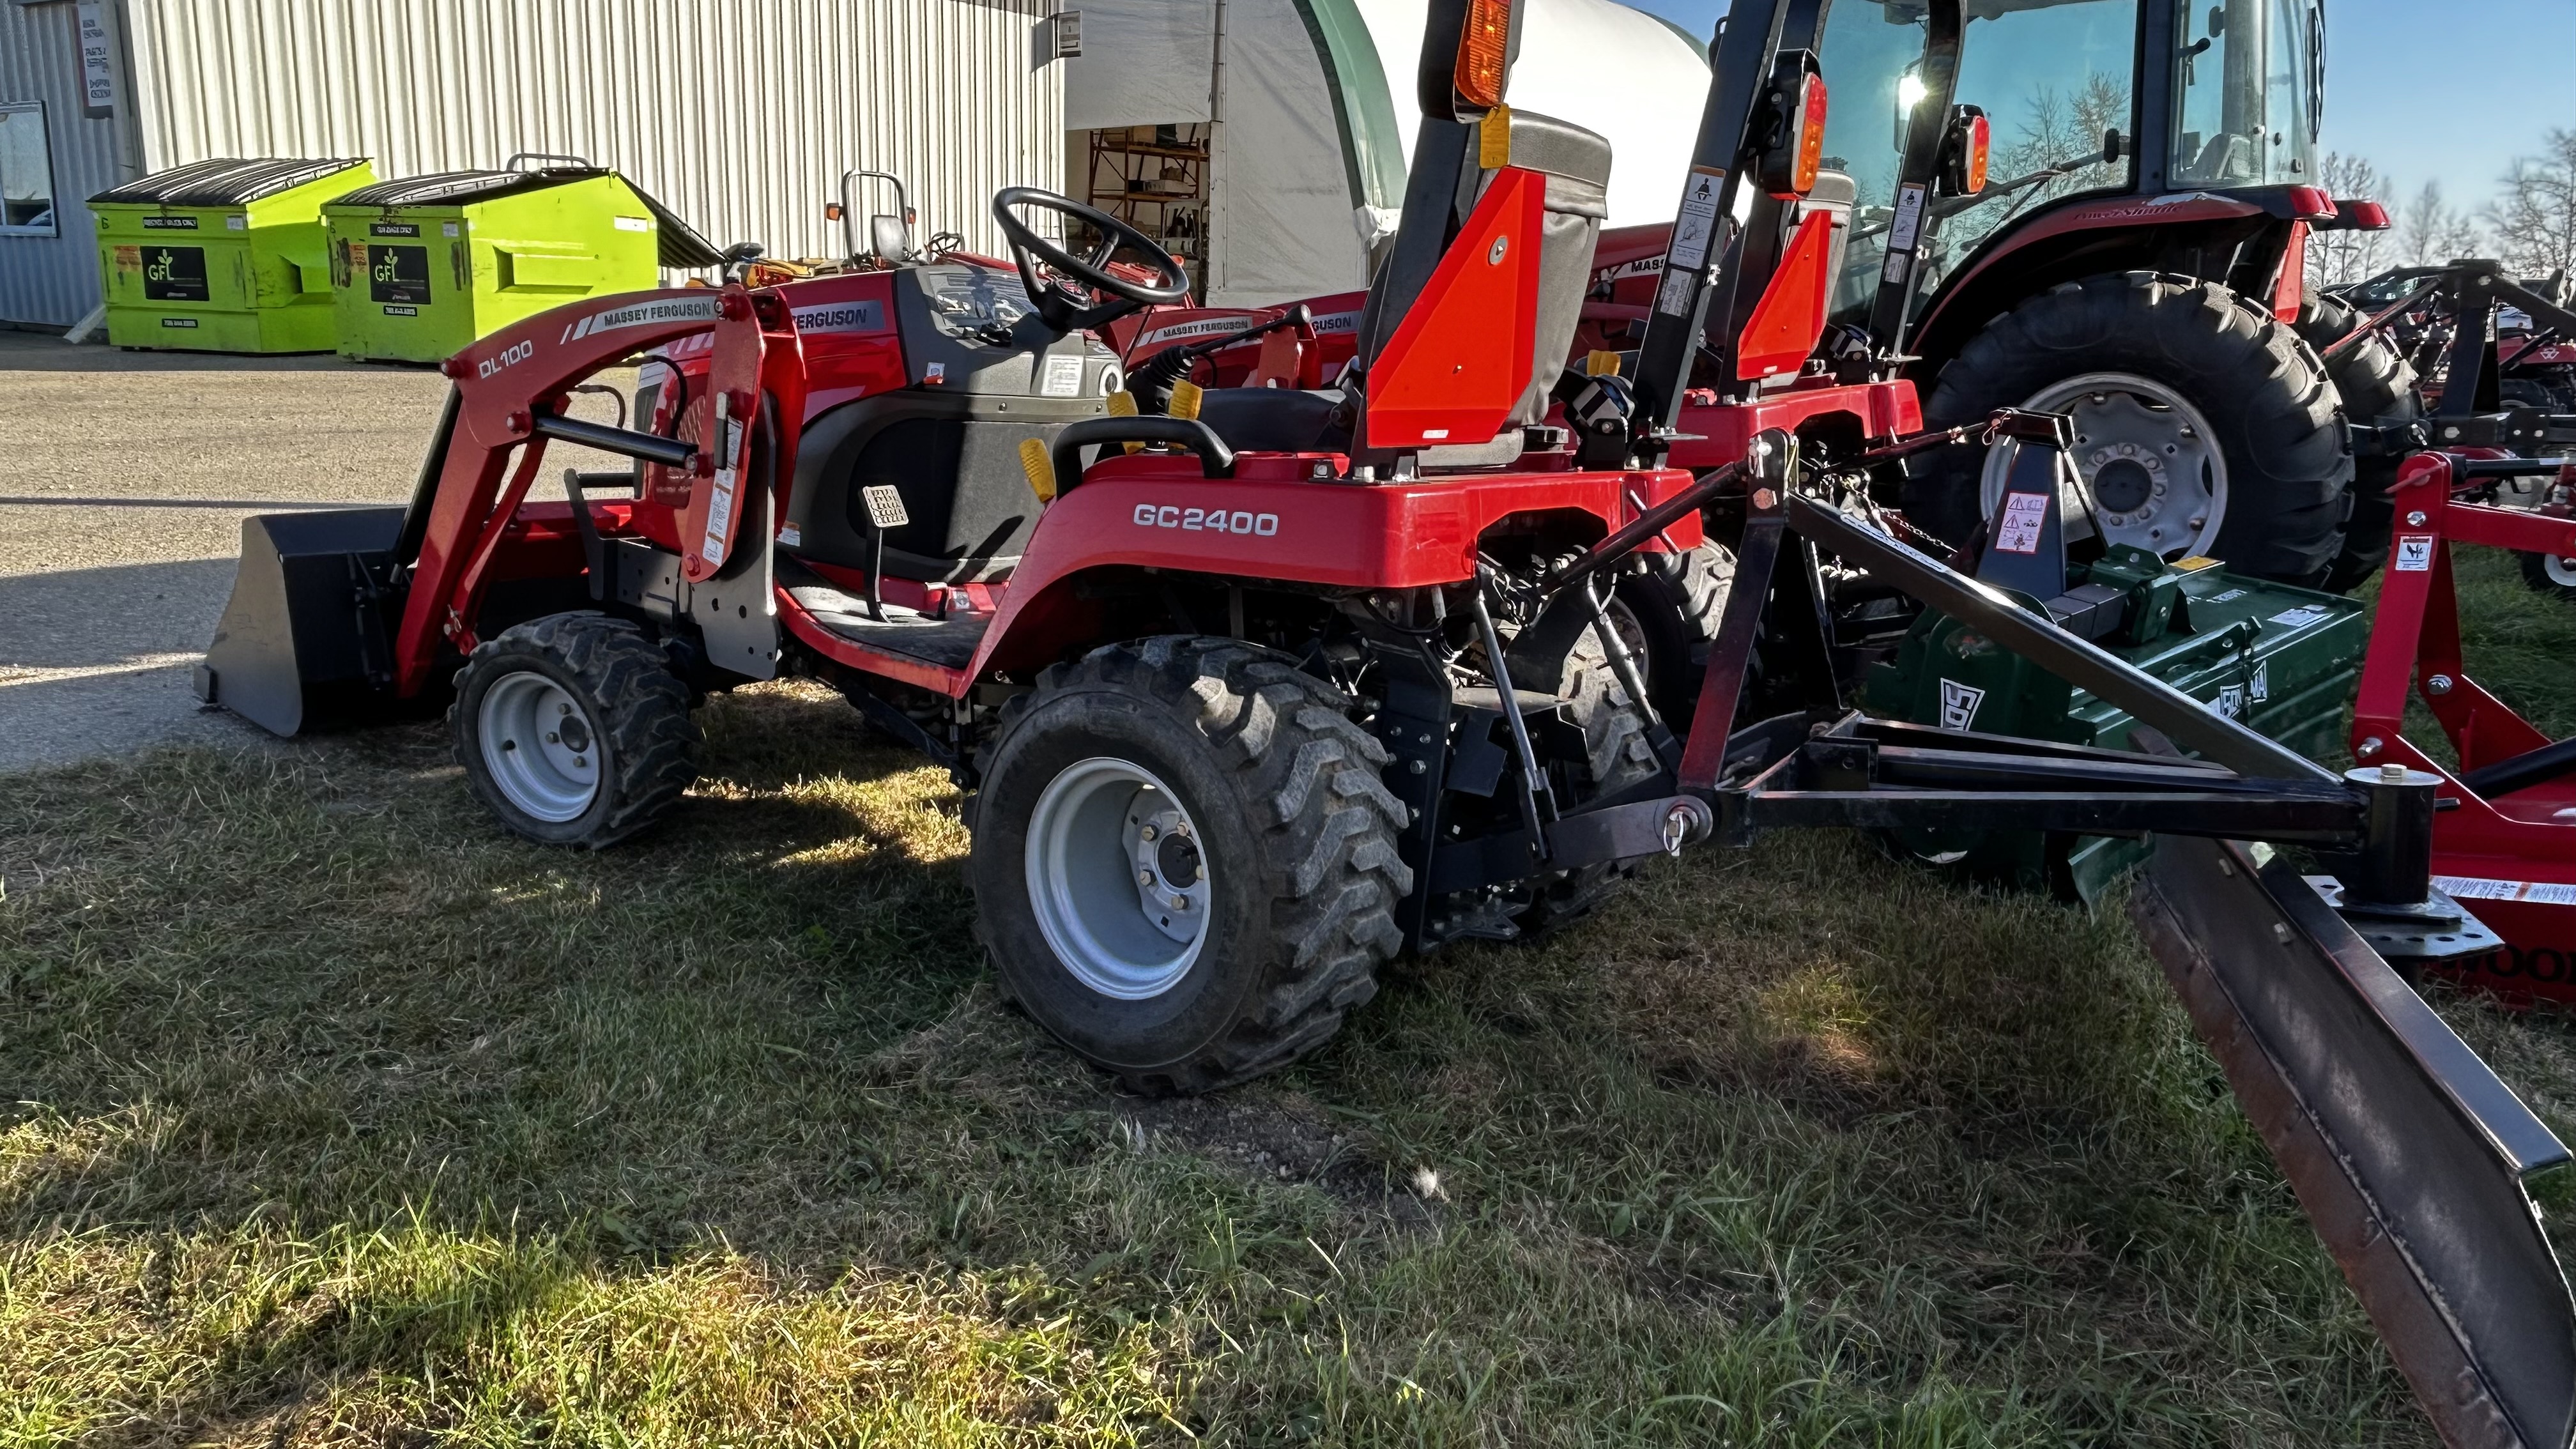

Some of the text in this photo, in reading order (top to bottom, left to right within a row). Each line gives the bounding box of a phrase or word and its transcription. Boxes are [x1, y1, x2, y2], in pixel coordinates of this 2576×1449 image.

[148, 263, 175, 282] GFL
[374, 263, 401, 282] GFL
[603, 302, 711, 327] MASSEY FERGUSON
[1133, 503, 1279, 536] GC2400
